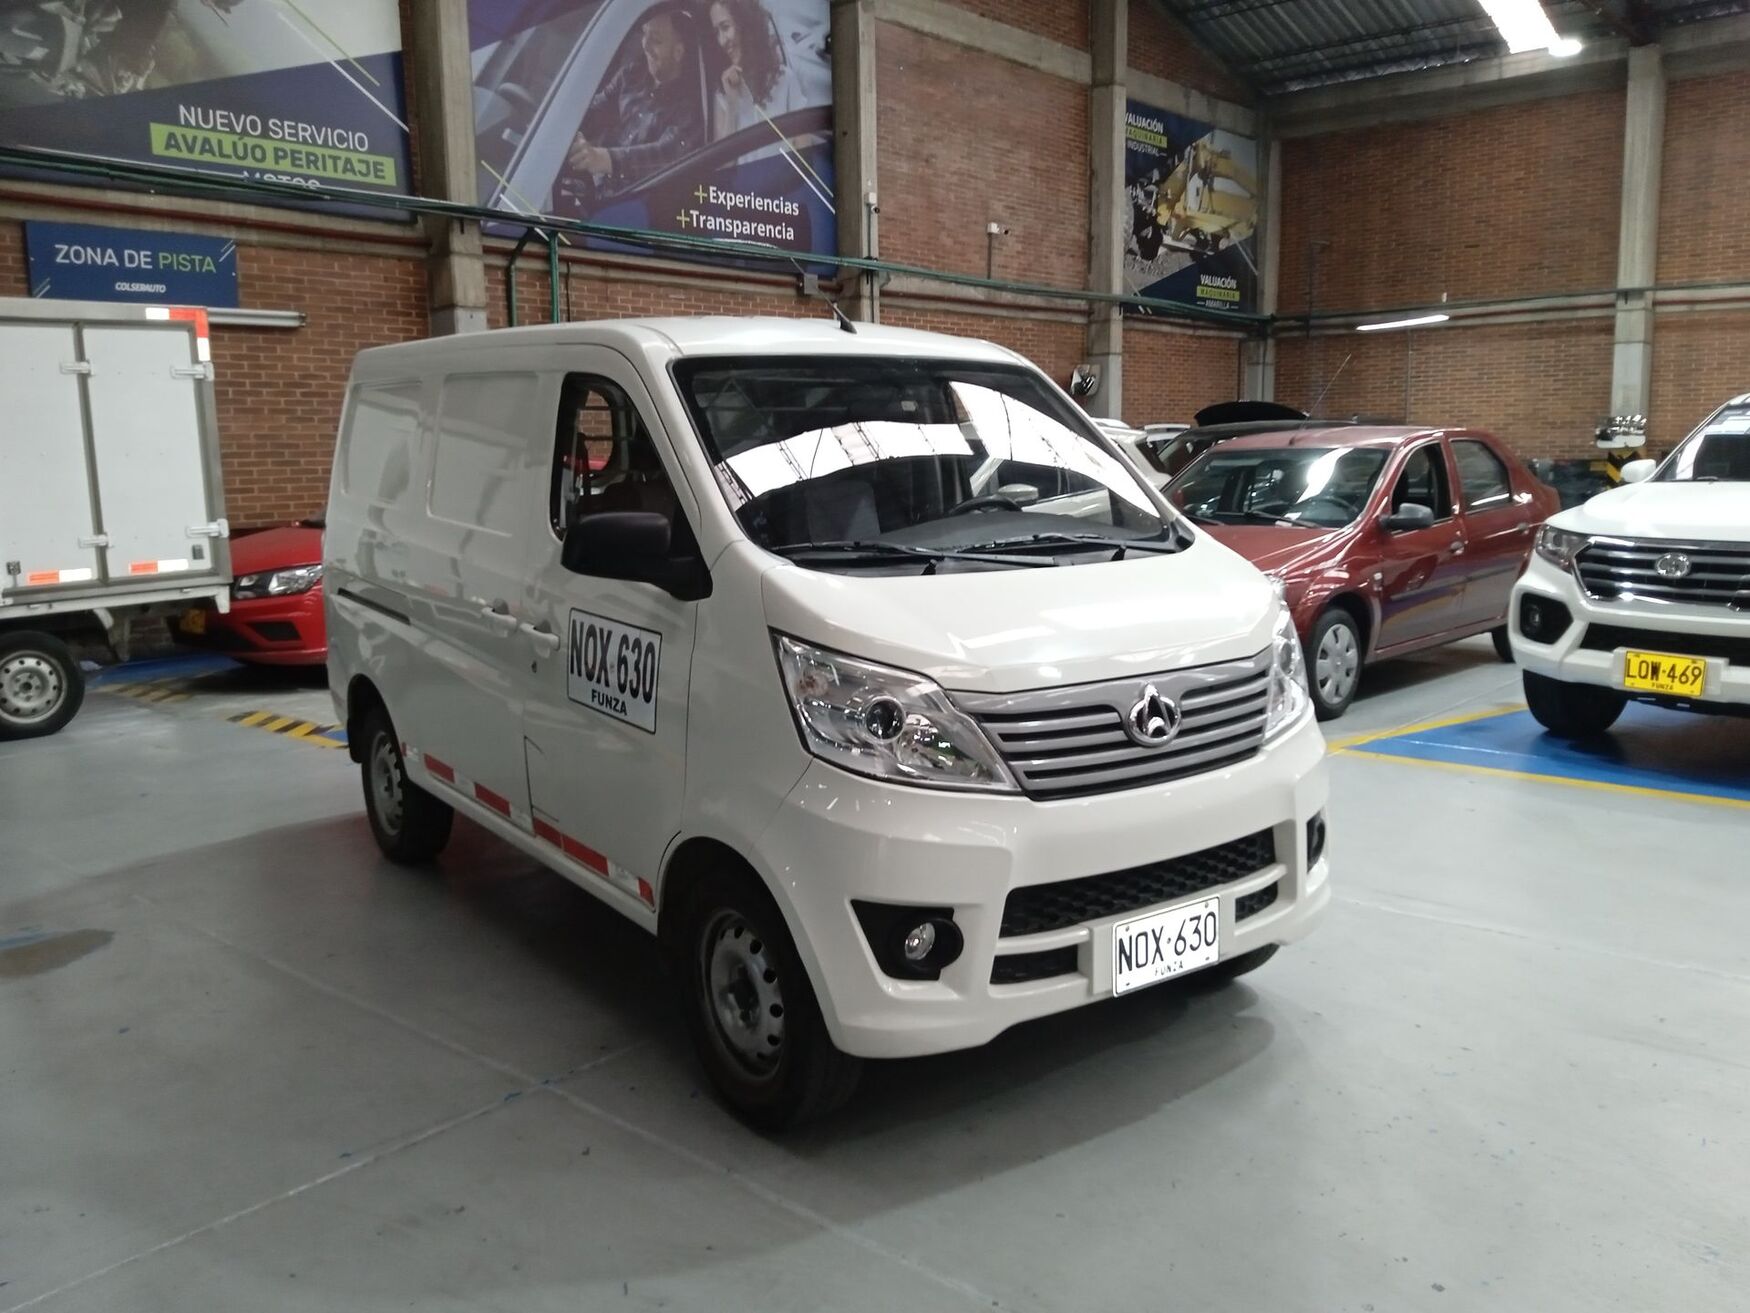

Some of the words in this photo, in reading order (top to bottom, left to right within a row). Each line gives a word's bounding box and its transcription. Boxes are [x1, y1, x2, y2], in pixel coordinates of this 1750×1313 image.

[178, 104, 262, 136] NUEVO
[268, 118, 369, 152] SERVICIO
[164, 130, 267, 163] AVALÚO
[273, 146, 387, 181] PERITAJE
[54, 244, 119, 267] ZONA
[124, 249, 153, 269] DE
[158, 252, 216, 273] PISTA
[1200, 274, 1237, 289] VALUACIÓN
[591, 689, 628, 716] FUNZA
